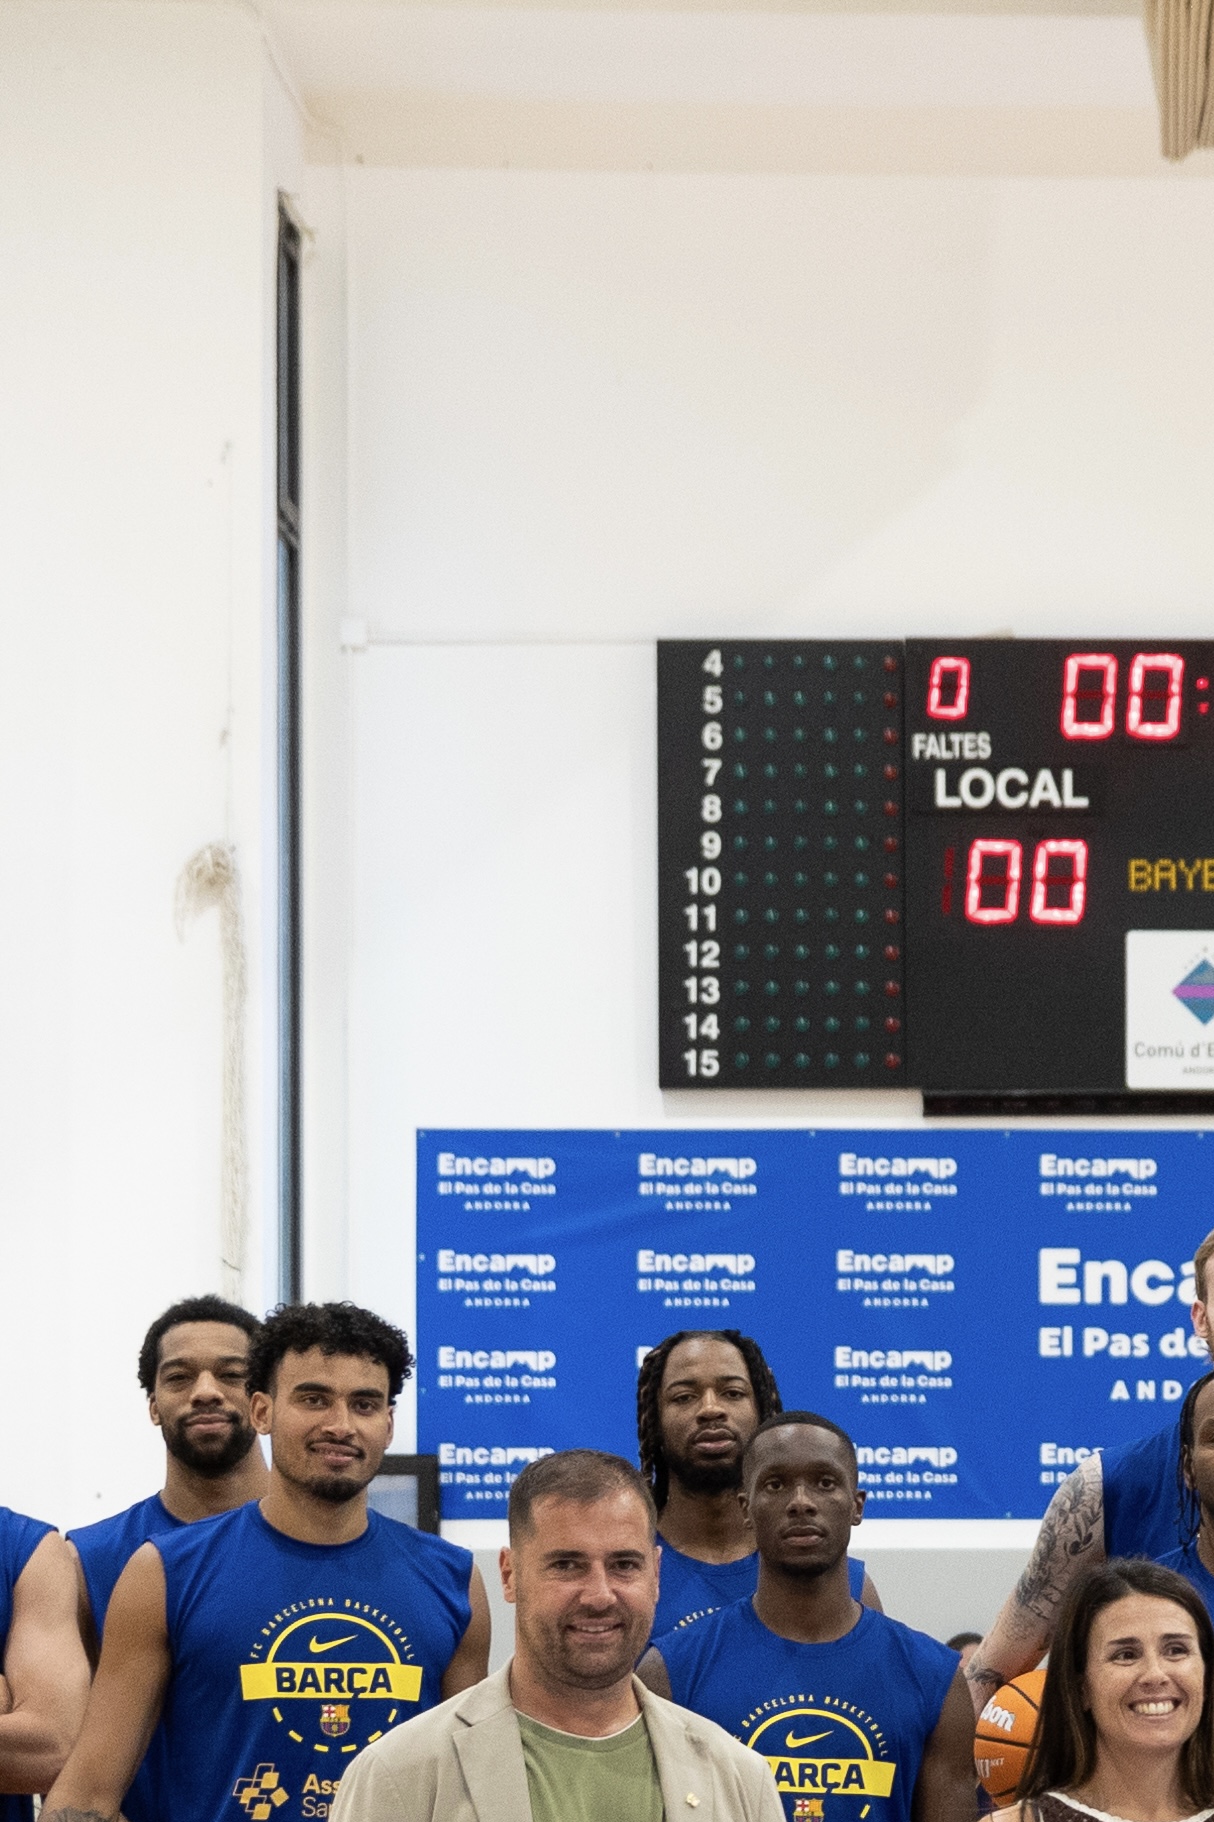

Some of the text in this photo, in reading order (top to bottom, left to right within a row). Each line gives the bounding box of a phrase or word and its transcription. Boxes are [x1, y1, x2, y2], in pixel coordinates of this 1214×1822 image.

[703, 650, 723, 677] 4
[704, 686, 723, 713] 5
[926, 656, 970, 721] 0
[702, 722, 722, 750] 6
[913, 732, 991, 760] FALTES
[703, 759, 722, 786] 7
[935, 768, 1089, 809] LOCAL
[702, 794, 722, 822] 8
[701, 831, 721, 859] 9
[686, 867, 721, 895] 10
[964, 838, 1088, 926] 00
[685, 904, 718, 931] 11
[685, 940, 720, 968] 12
[685, 976, 720, 1004] 13
[684, 1013, 720, 1040] 14
[684, 1049, 719, 1076] 15
[1134, 1041, 1185, 1058] Comú
[438, 1153, 556, 1179] Encamp
[639, 1153, 757, 1179] Encamp
[839, 1153, 957, 1179] Encamp
[1040, 1154, 1157, 1180] Encamp
[438, 1182, 556, 1195] El Pas de la Casa
[840, 1182, 957, 1195] El Pas de la Casa
[464, 1201, 530, 1211] ANDORRA
[866, 1201, 931, 1211] ANDORRA
[438, 1250, 556, 1275] Encamp
[637, 1250, 755, 1275] Encamp
[837, 1250, 954, 1275] Encamp
[637, 1278, 755, 1292] El Pas de la Casa
[837, 1278, 954, 1292] El Pas de la Casa
[664, 1297, 729, 1307] ANDORRA
[864, 1297, 928, 1307] ANDORRA
[1039, 1326, 1072, 1357] El
[1083, 1328, 1149, 1357] Pas
[438, 1346, 556, 1372] Encamp
[835, 1346, 952, 1371] Encamp
[438, 1375, 556, 1388] El Pas de la Casa
[465, 1394, 530, 1404] ANDORRA
[852, 1444, 957, 1468] ncamp
[275, 1667, 393, 1698] BARÇA
[767, 1761, 865, 1793] ARÇA
